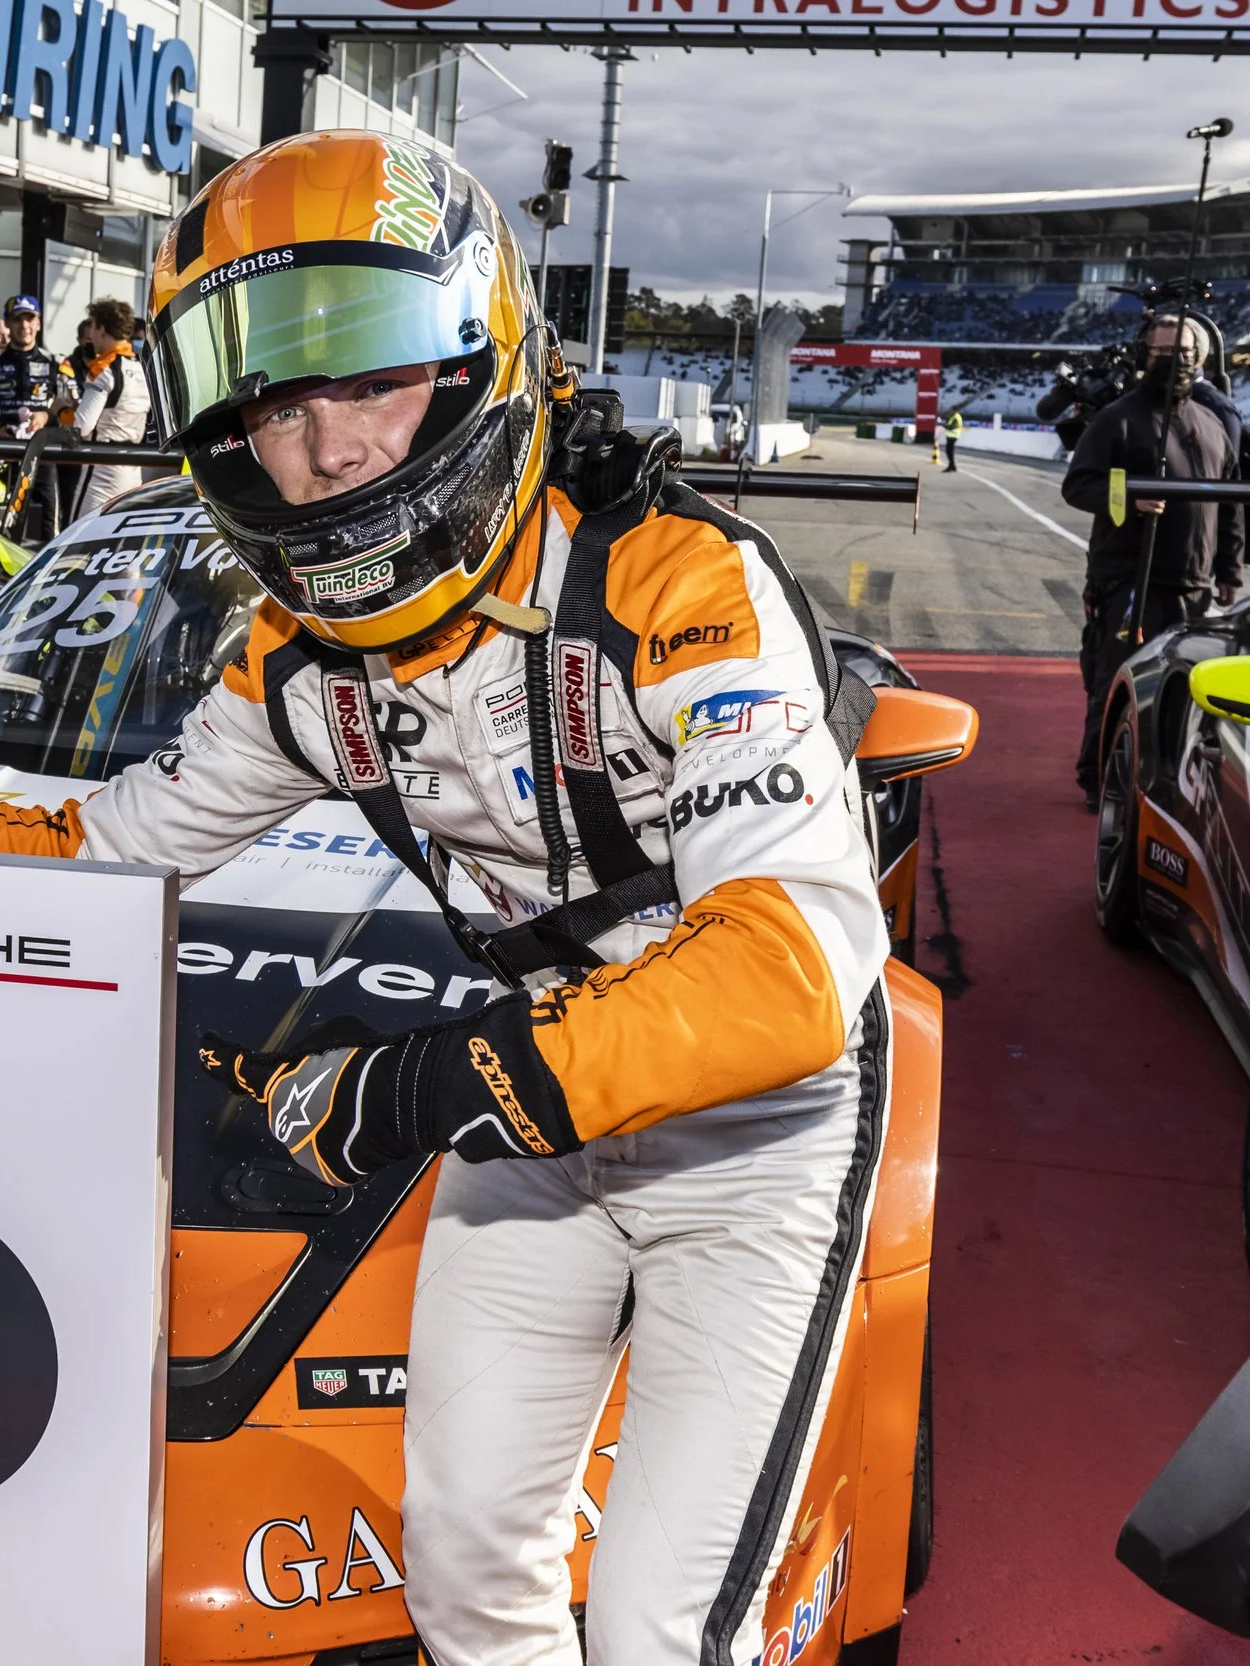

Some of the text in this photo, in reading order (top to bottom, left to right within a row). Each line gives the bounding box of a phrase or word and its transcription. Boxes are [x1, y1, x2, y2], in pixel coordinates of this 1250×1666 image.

[199, 249, 295, 293] atténtas
[436, 370, 470, 387] stilo
[84, 546, 166, 576] ten
[291, 540, 406, 603] Tuindeco
[564, 653, 590, 760] SIMPSON
[334, 685, 376, 778] SIMPSON
[1150, 841, 1185, 876] BOSS
[315, 1371, 345, 1380] TAG
[315, 1380, 346, 1394] HEUER
[752, 1561, 829, 1666] obil
